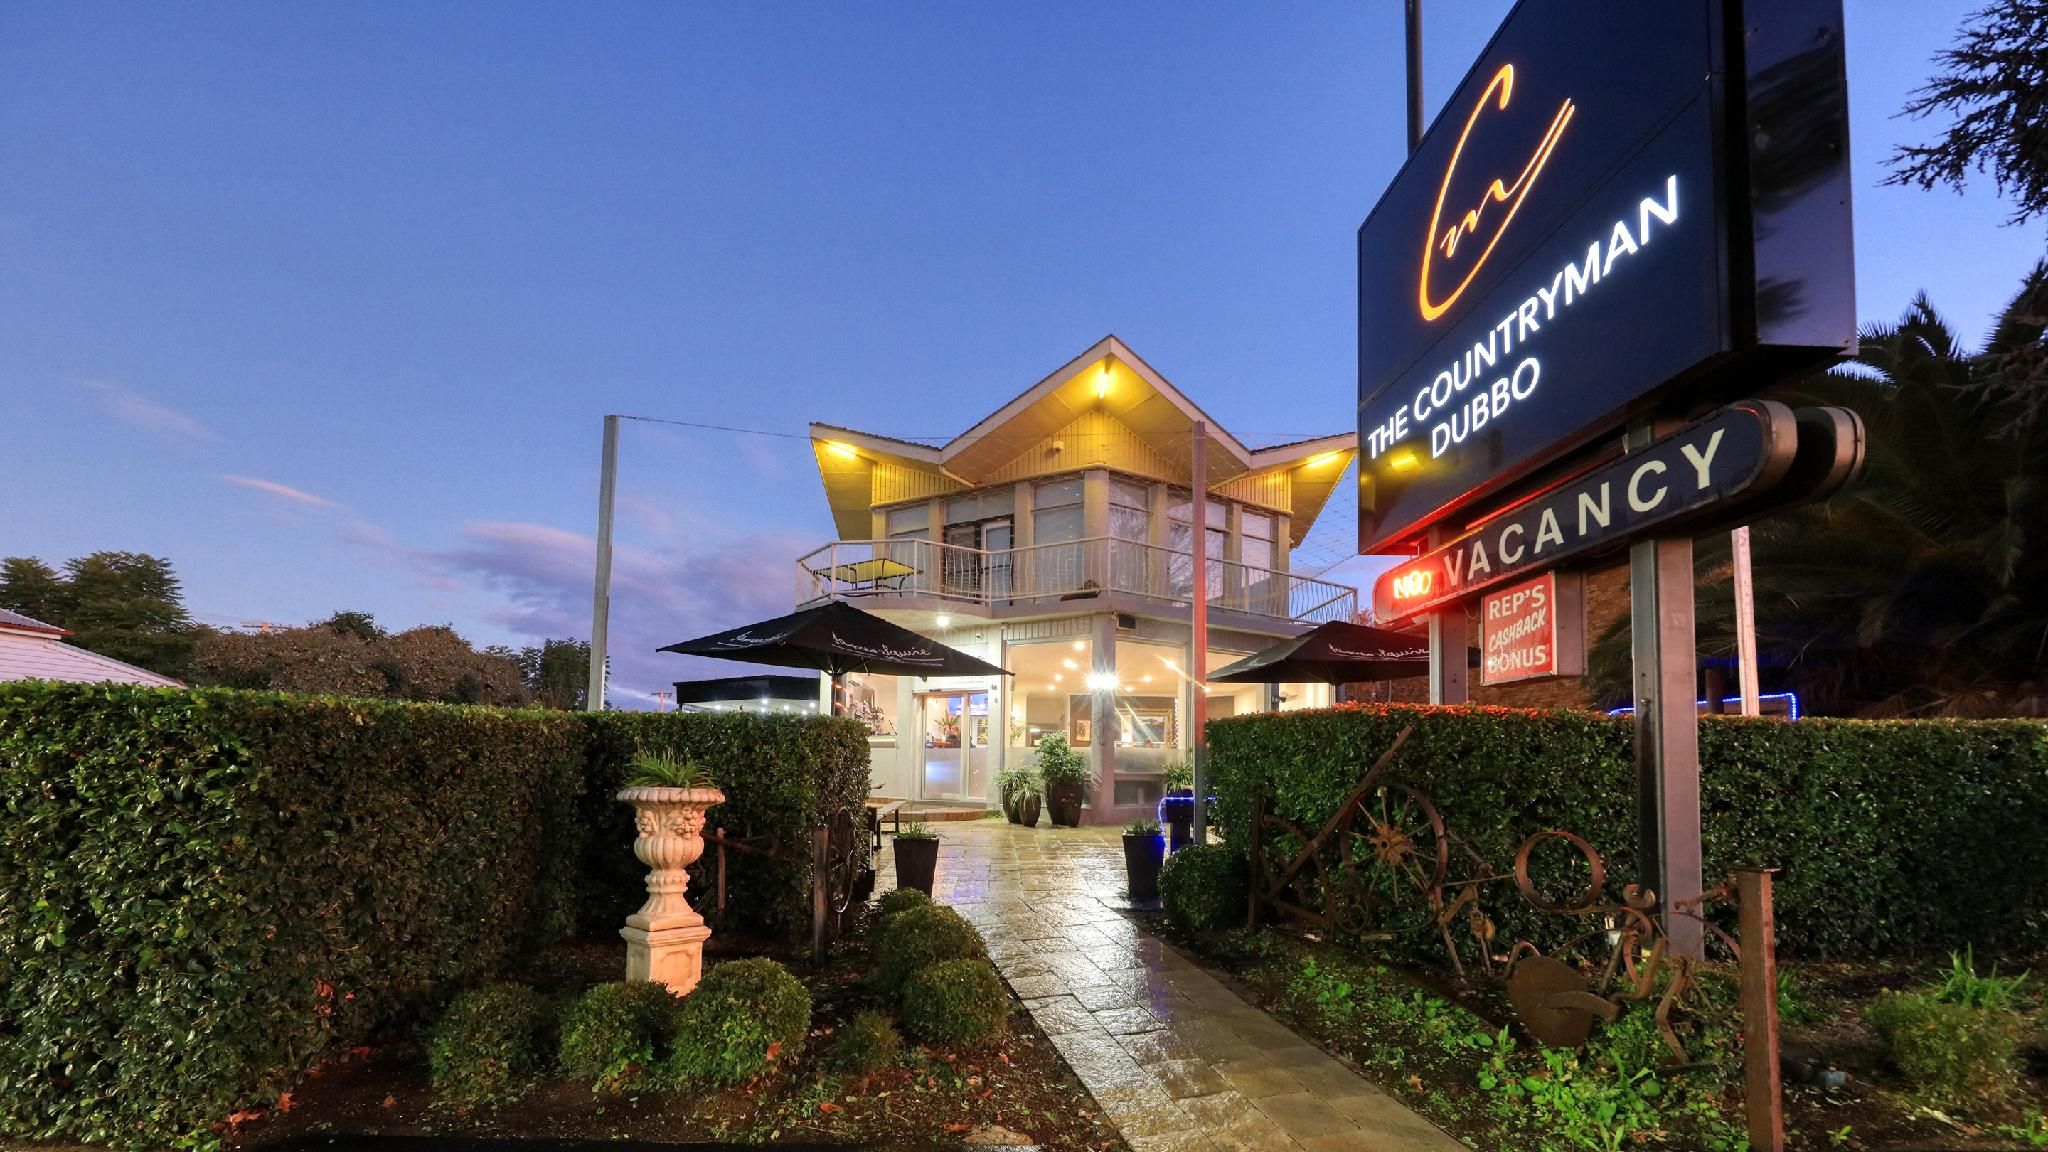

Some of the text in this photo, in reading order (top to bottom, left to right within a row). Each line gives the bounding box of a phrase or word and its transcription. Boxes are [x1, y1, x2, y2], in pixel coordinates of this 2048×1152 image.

[1368, 174, 1679, 460] THE COUNTRYMAN
[1431, 357, 1541, 460] DUBBO
[1443, 428, 1726, 587] VACANCY
[1488, 608, 1547, 653] CASHBACK
[1489, 584, 1546, 621] REP'S
[1488, 645, 1547, 674] BONUS
